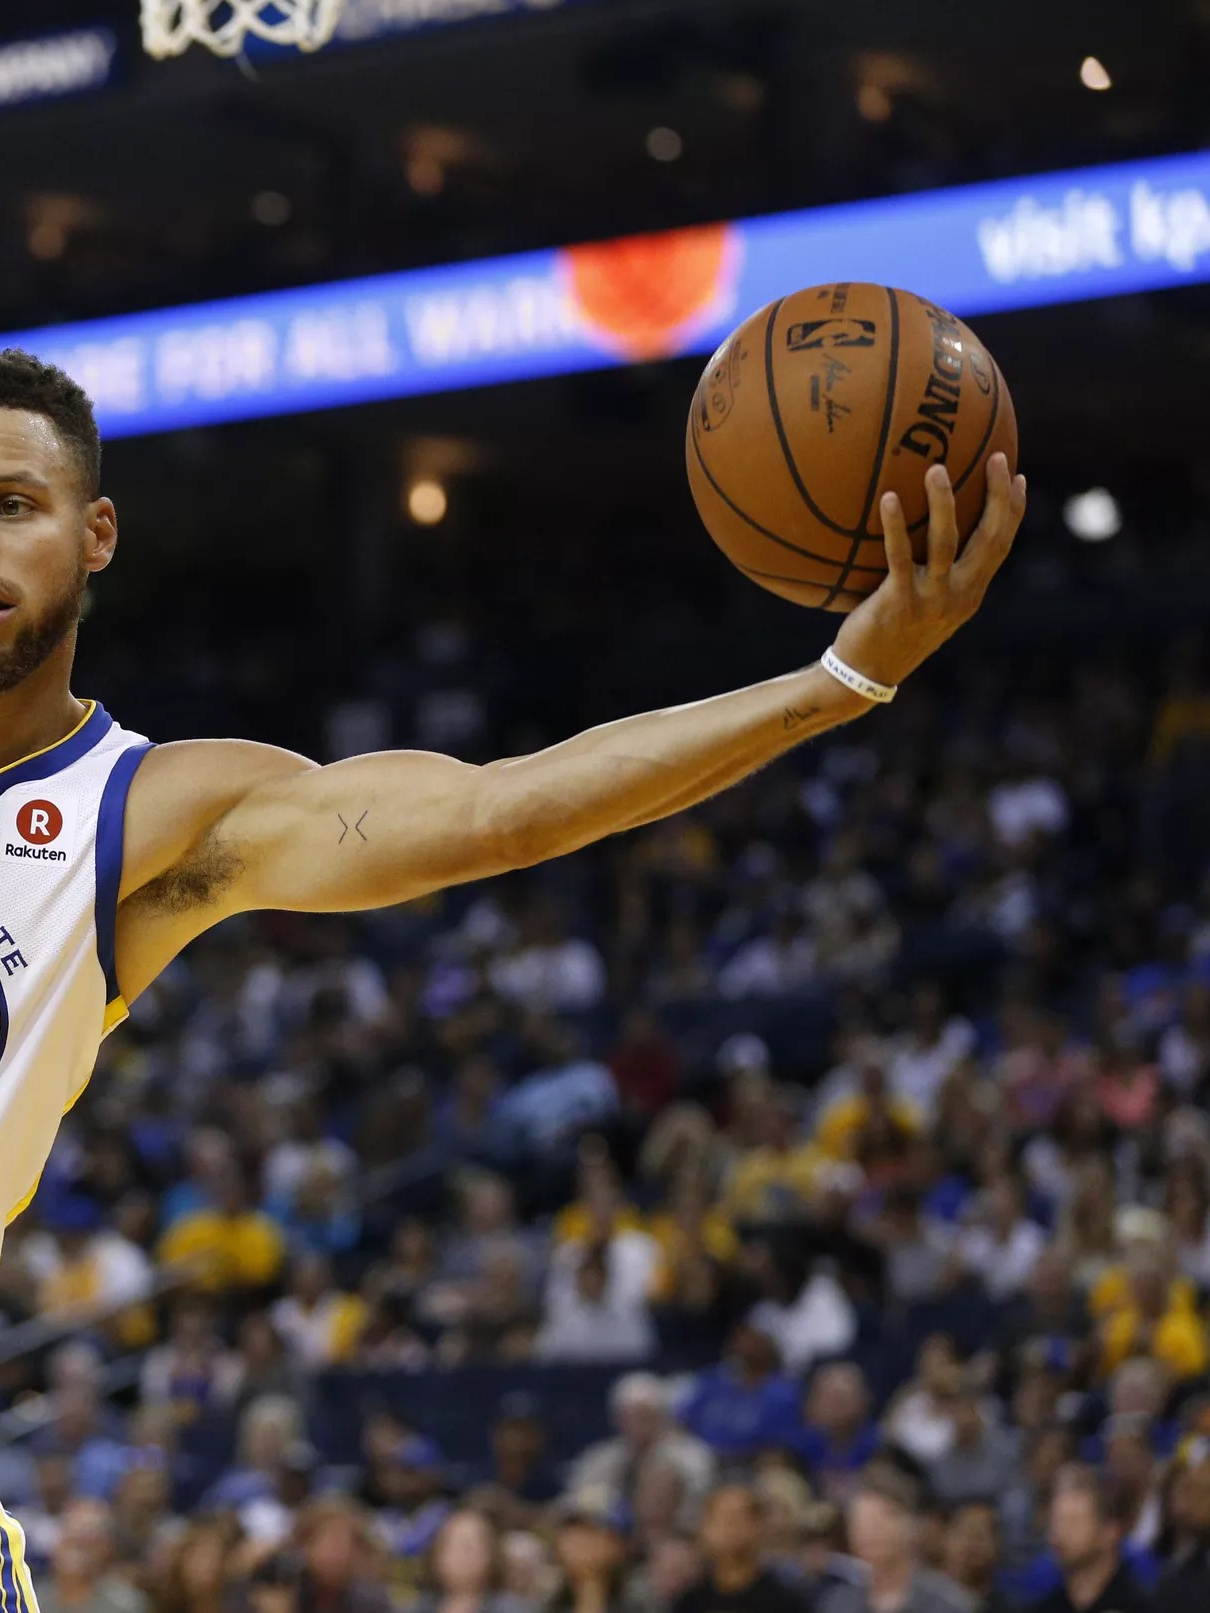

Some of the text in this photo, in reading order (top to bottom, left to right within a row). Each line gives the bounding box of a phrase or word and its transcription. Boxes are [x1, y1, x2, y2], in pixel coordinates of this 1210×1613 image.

[826, 657, 856, 684] NAME
[30, 808, 50, 836] R
[5, 843, 67, 862] Rakuten
